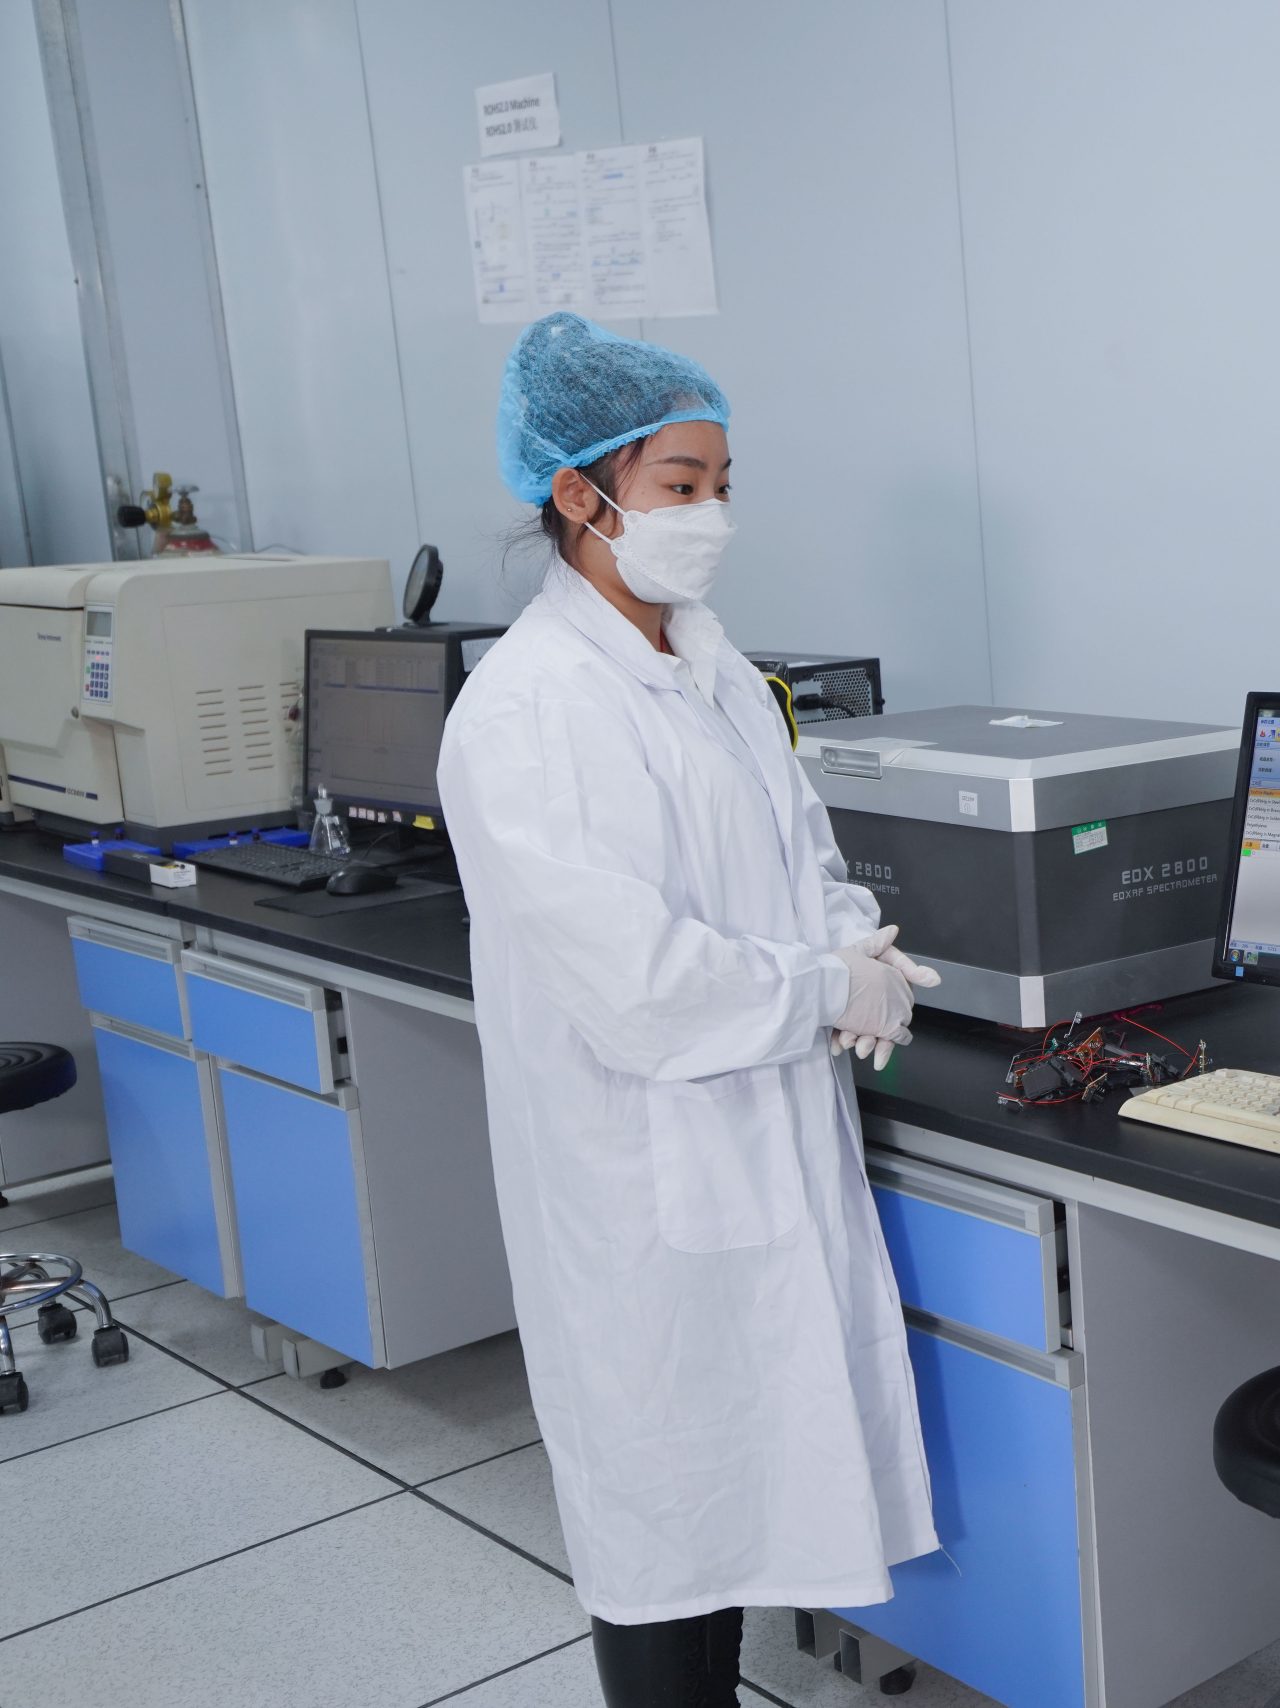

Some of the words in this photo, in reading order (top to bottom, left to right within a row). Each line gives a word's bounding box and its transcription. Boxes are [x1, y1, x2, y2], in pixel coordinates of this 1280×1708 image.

[855, 861, 892, 880] 2800
[1121, 865, 1154, 885] EDX
[1161, 856, 1208, 878] 2800
[1112, 887, 1144, 901] EDXRF
[1146, 873, 1218, 895] SPECTROMETER
